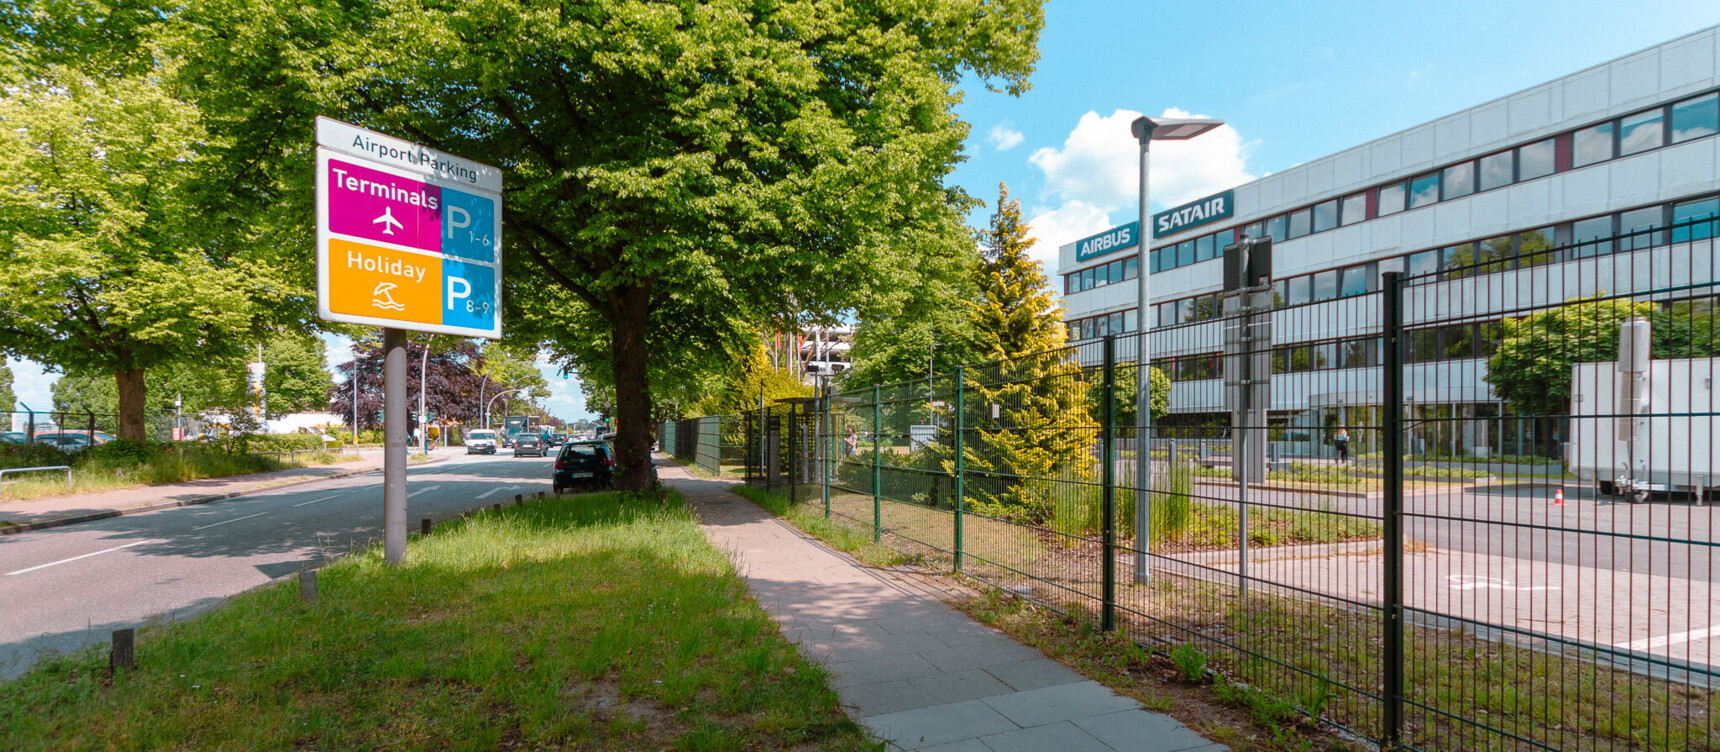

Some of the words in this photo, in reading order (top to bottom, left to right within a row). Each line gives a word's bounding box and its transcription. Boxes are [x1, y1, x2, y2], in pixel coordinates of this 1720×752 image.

[352, 134, 413, 164] Airport
[420, 152, 477, 184] Parking
[332, 168, 439, 210] Terminals
[447, 204, 471, 239] P
[468, 230, 490, 247] 1-6
[1158, 197, 1225, 233] SATAIR
[1080, 227, 1131, 257] AIRBUS
[347, 250, 426, 283] Holiday
[447, 275, 472, 310] P
[465, 299, 490, 315] 8-9
